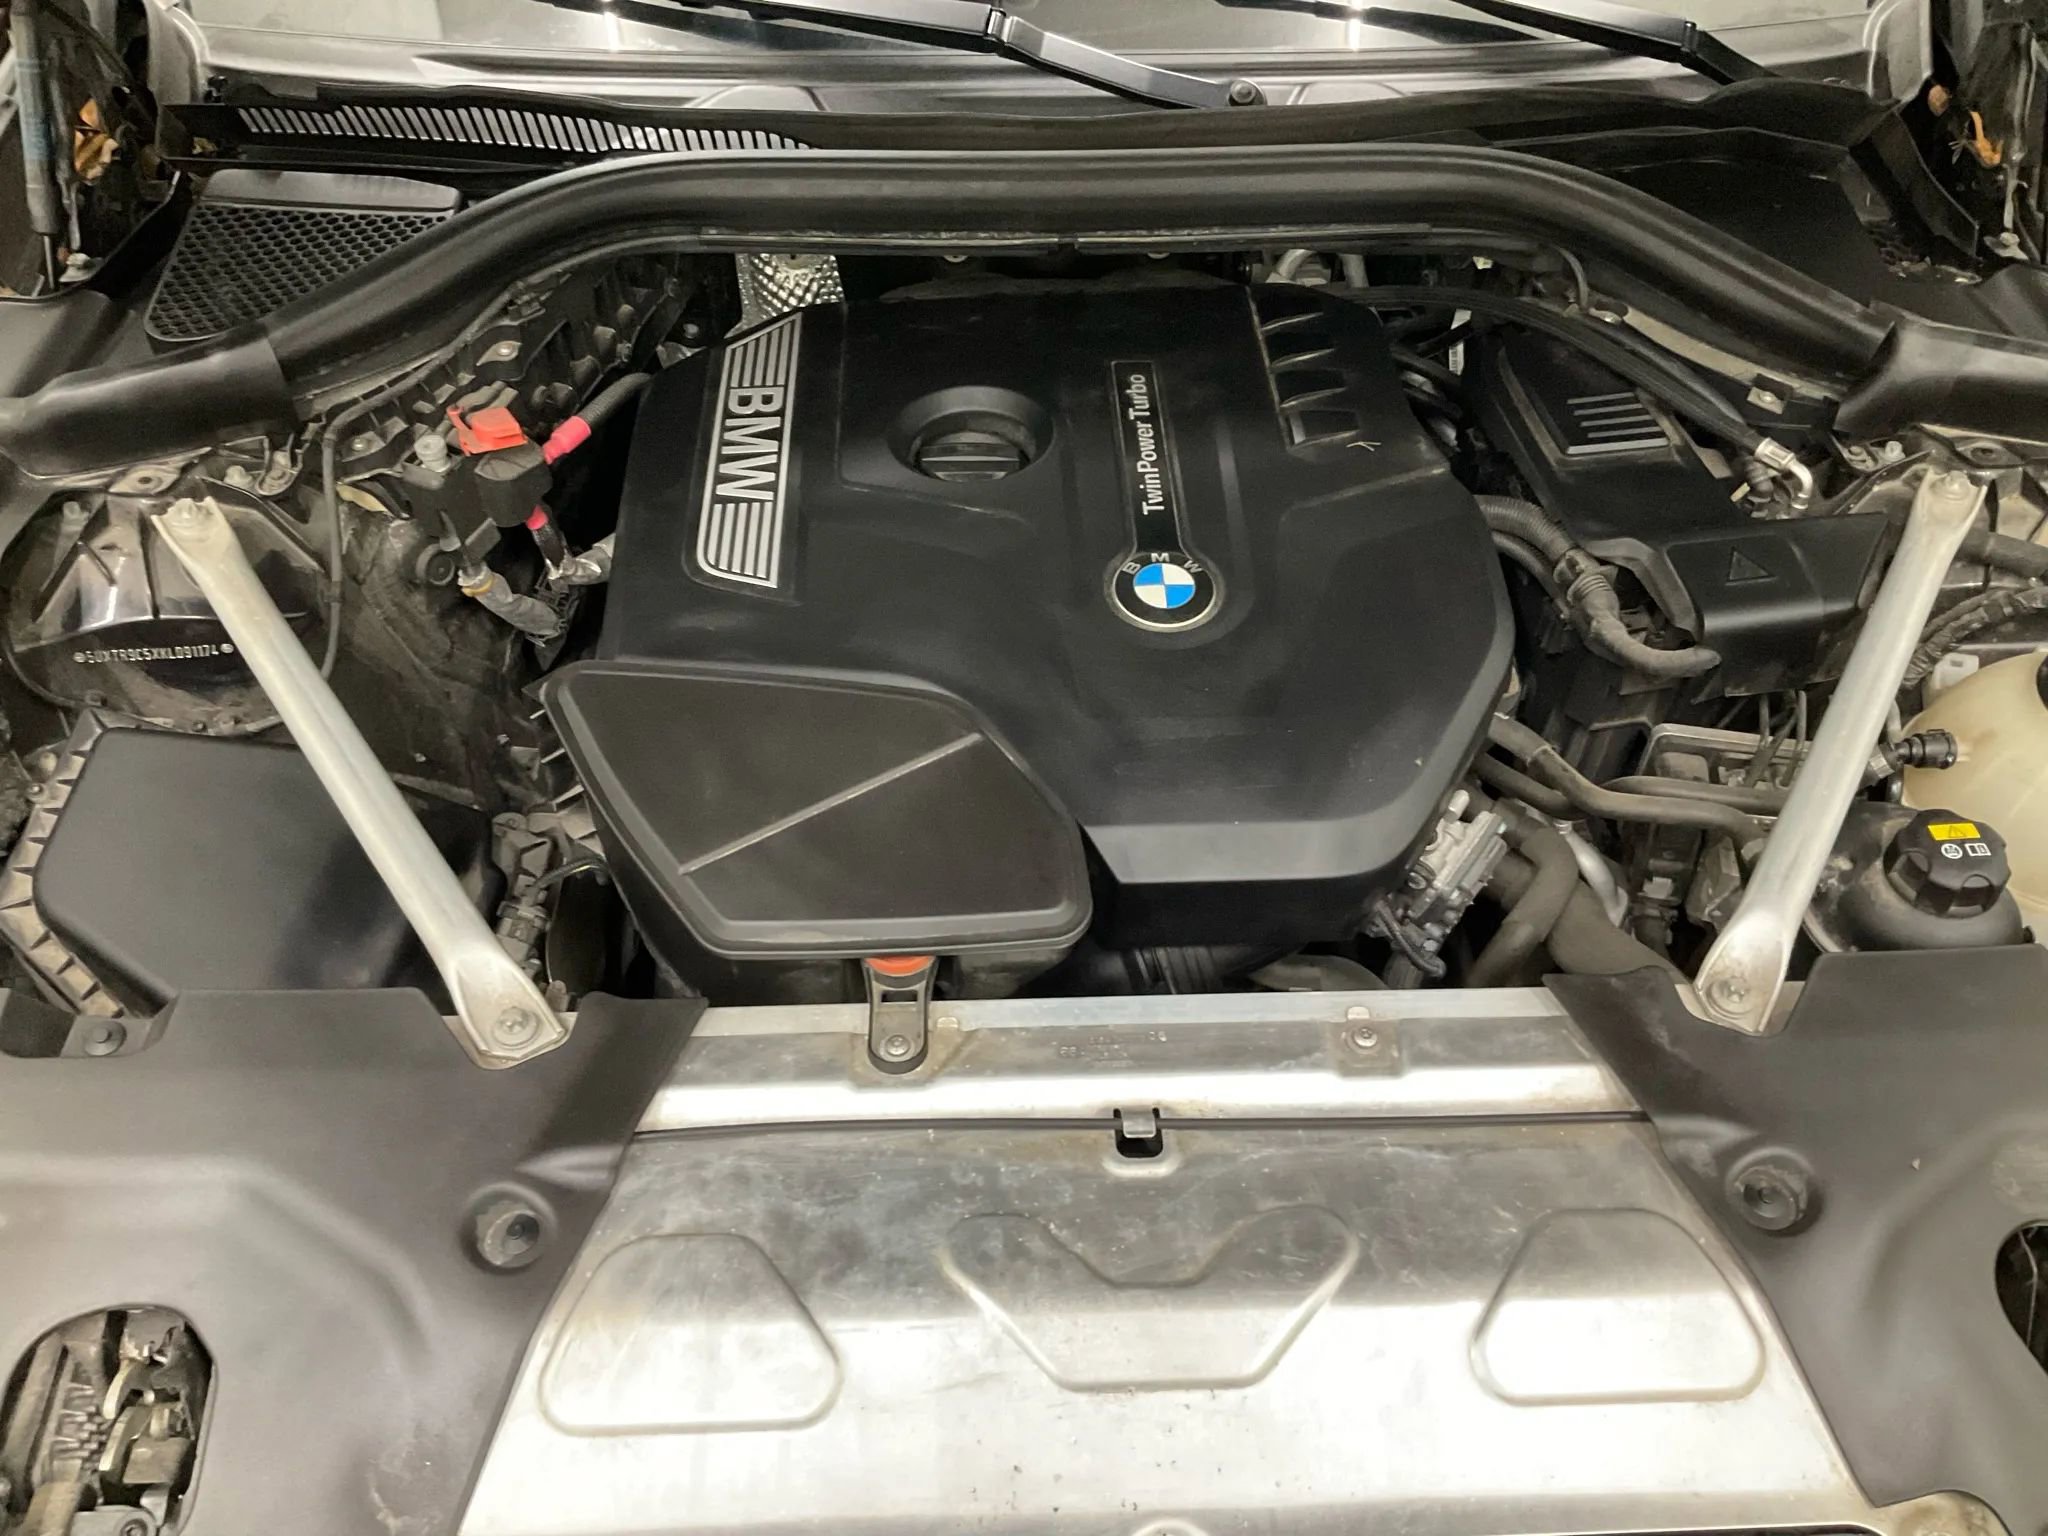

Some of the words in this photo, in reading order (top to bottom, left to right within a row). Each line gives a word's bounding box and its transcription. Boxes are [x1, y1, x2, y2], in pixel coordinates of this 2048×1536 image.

[1126, 374, 1150, 420] Turbo
[716, 387, 784, 500] BMW
[1137, 420, 1165, 515] TwinPower
[1122, 552, 1203, 575] BMW
